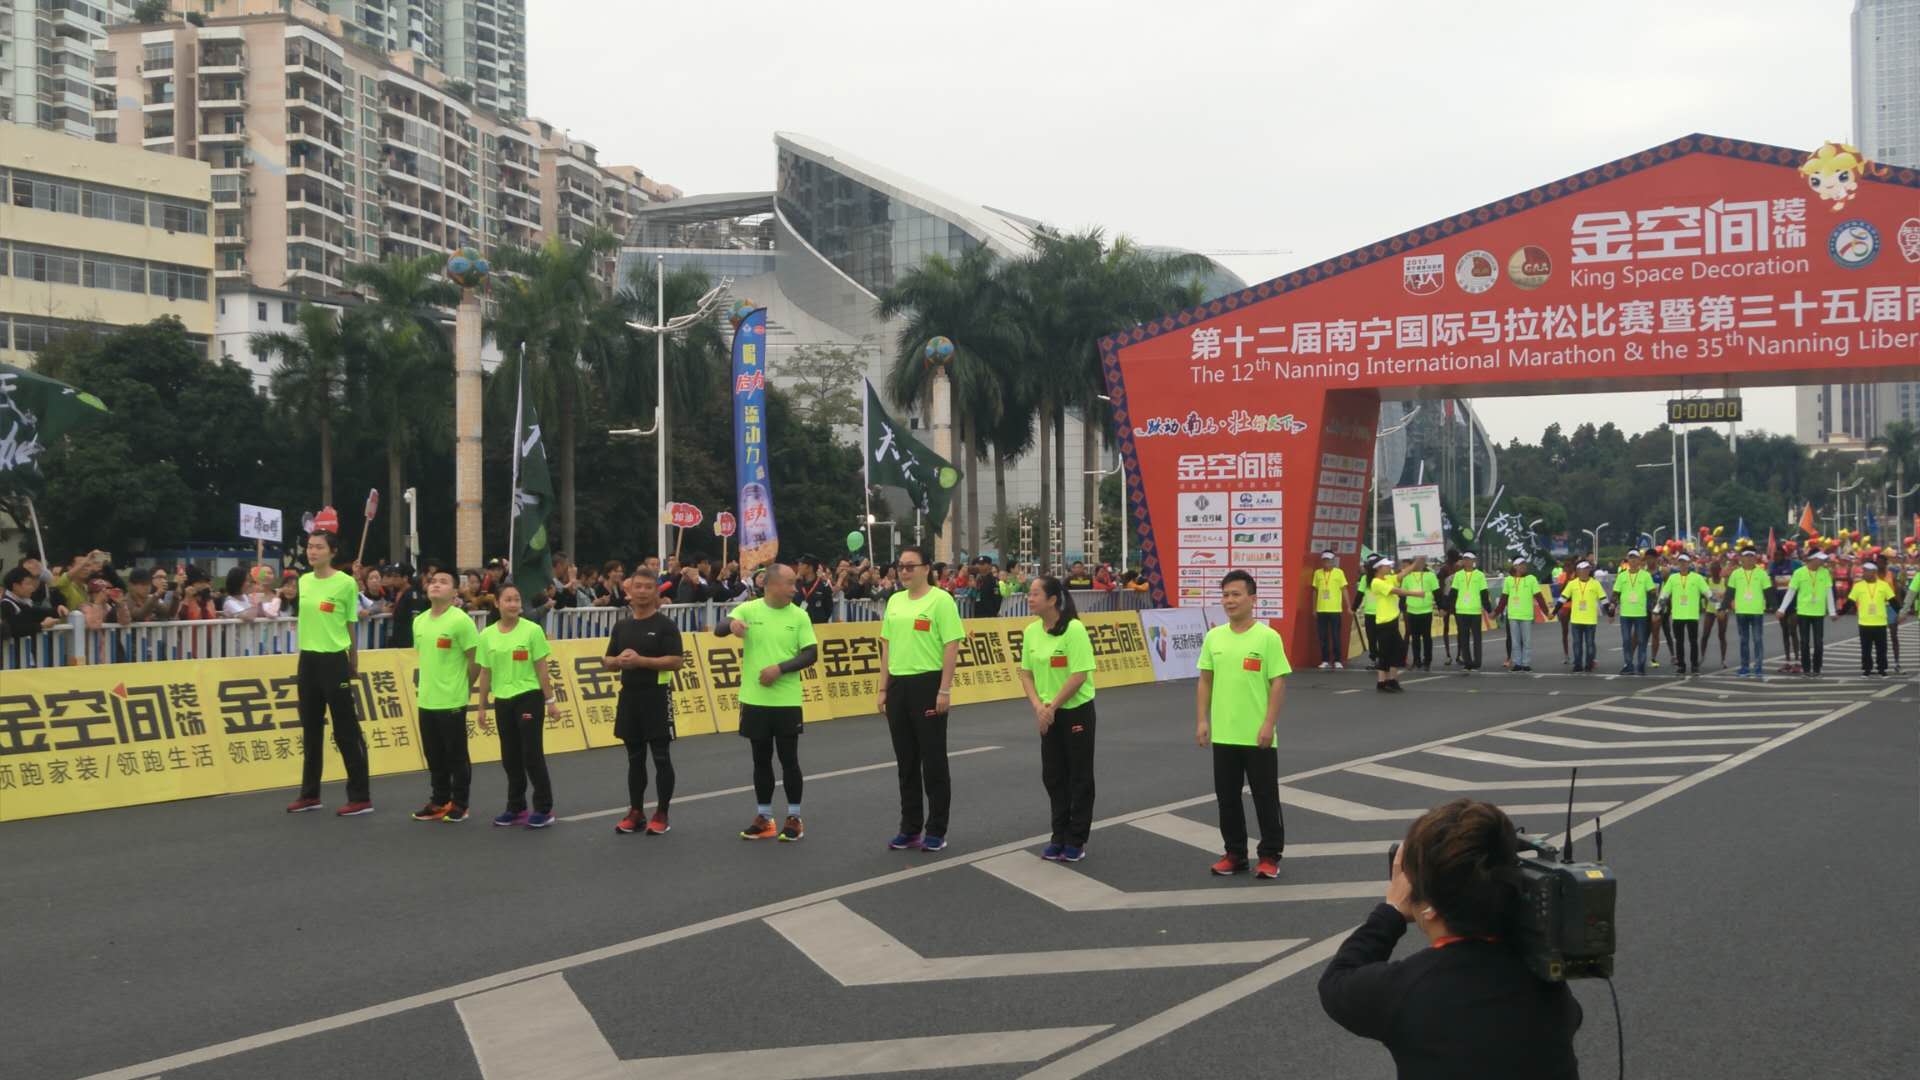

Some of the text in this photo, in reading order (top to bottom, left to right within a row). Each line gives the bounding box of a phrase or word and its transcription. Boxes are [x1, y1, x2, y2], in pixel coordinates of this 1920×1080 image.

[1571, 198, 1769, 264] 金空间
[1772, 198, 1807, 248] 装饰
[1571, 268, 1615, 290] King
[1623, 265, 1684, 287] Space
[1691, 256, 1809, 280] Decoration
[1190, 365, 1225, 384] The
[1231, 357, 1270, 382] 12th
[1275, 357, 1360, 381] Nanning
[1366, 348, 1501, 375] International
[1508, 342, 1616, 367] Marathon
[1624, 341, 1644, 361] &
[1651, 339, 1688, 360] the
[1696, 331, 1744, 358] 35th
[1747, 331, 1849, 357] Nanning
[1672, 402, 1737, 419] 0:00:00
[1178, 451, 1266, 480] 金空间
[1410, 503, 1421, 532] 1
[371, 670, 403, 719] 装饰
[0, 683, 207, 756] 金空间 装饰
